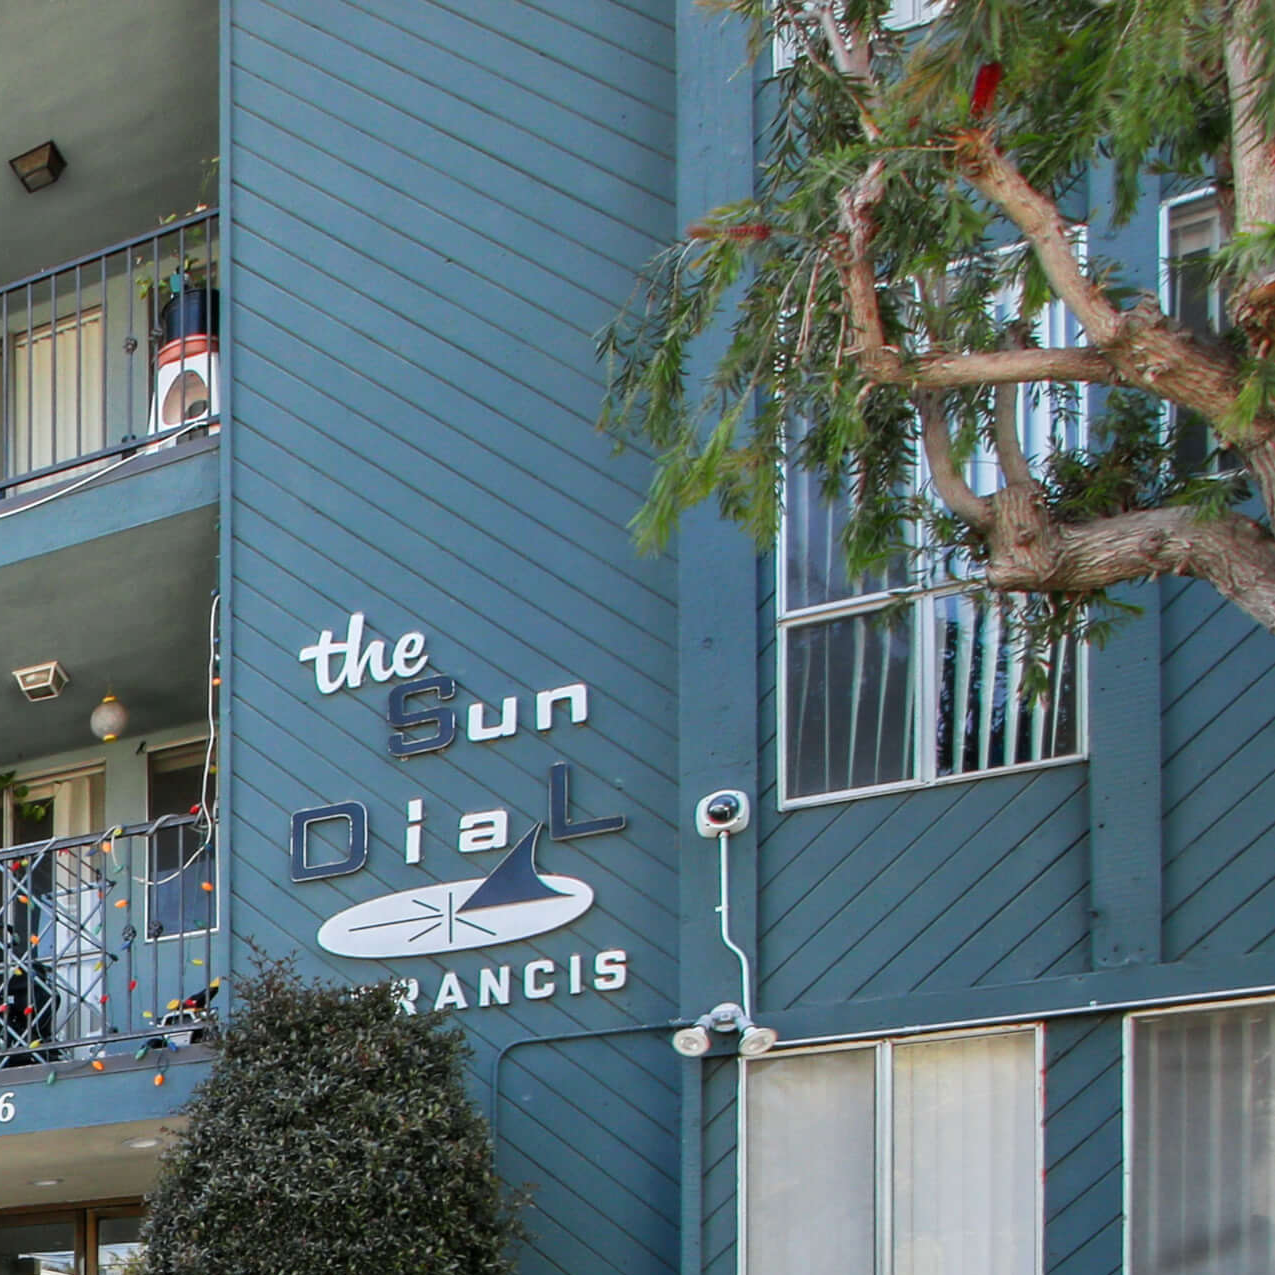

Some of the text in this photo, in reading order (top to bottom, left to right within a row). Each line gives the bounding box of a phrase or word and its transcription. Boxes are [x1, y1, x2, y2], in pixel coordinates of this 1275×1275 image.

[298, 611, 429, 695] the
[387, 674, 589, 759] Sun
[350, 949, 628, 1016] RANCIS
